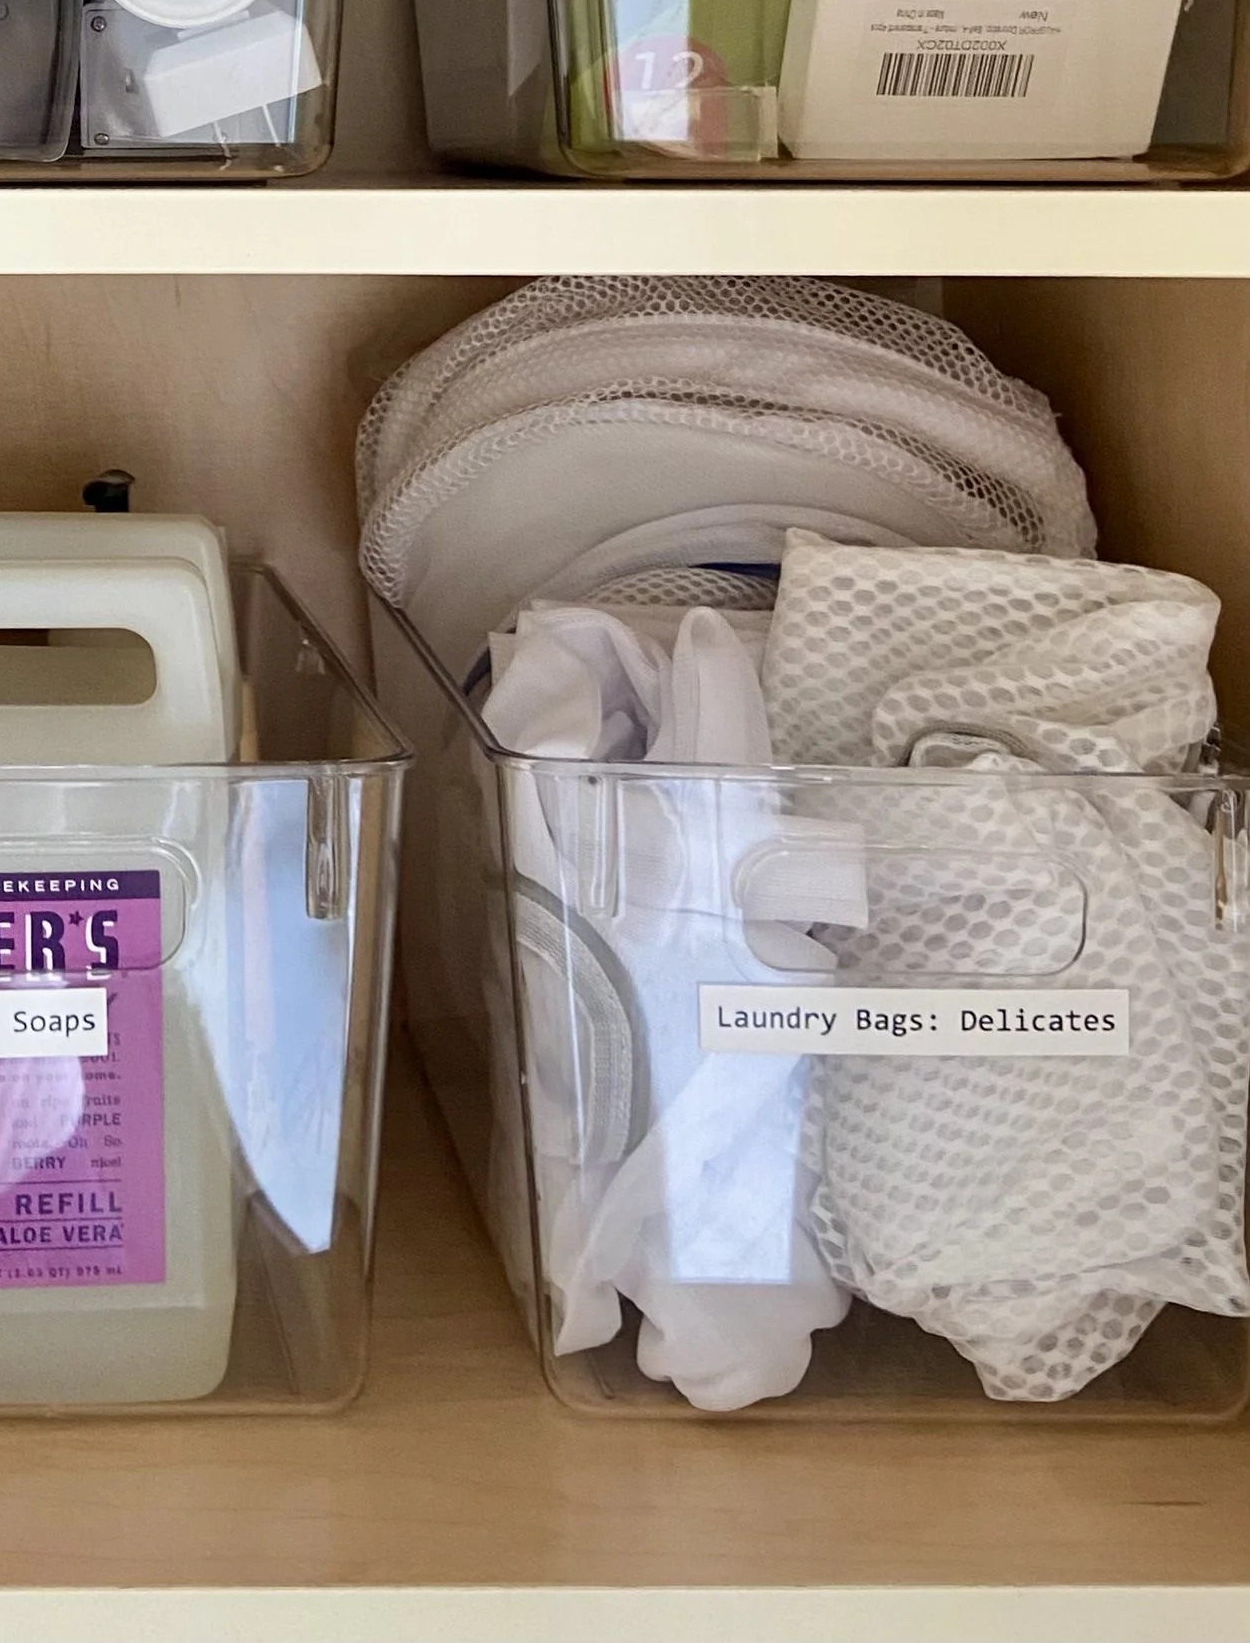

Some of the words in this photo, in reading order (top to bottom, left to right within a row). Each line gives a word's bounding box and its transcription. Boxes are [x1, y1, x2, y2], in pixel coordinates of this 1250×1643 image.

[13, 1010, 96, 1038] Soaps
[717, 1006, 838, 1038] Laundry
[856, 1007, 939, 1038] Bags:
[960, 1007, 1116, 1034] Delicates
[15, 1191, 123, 1216] REFILL
